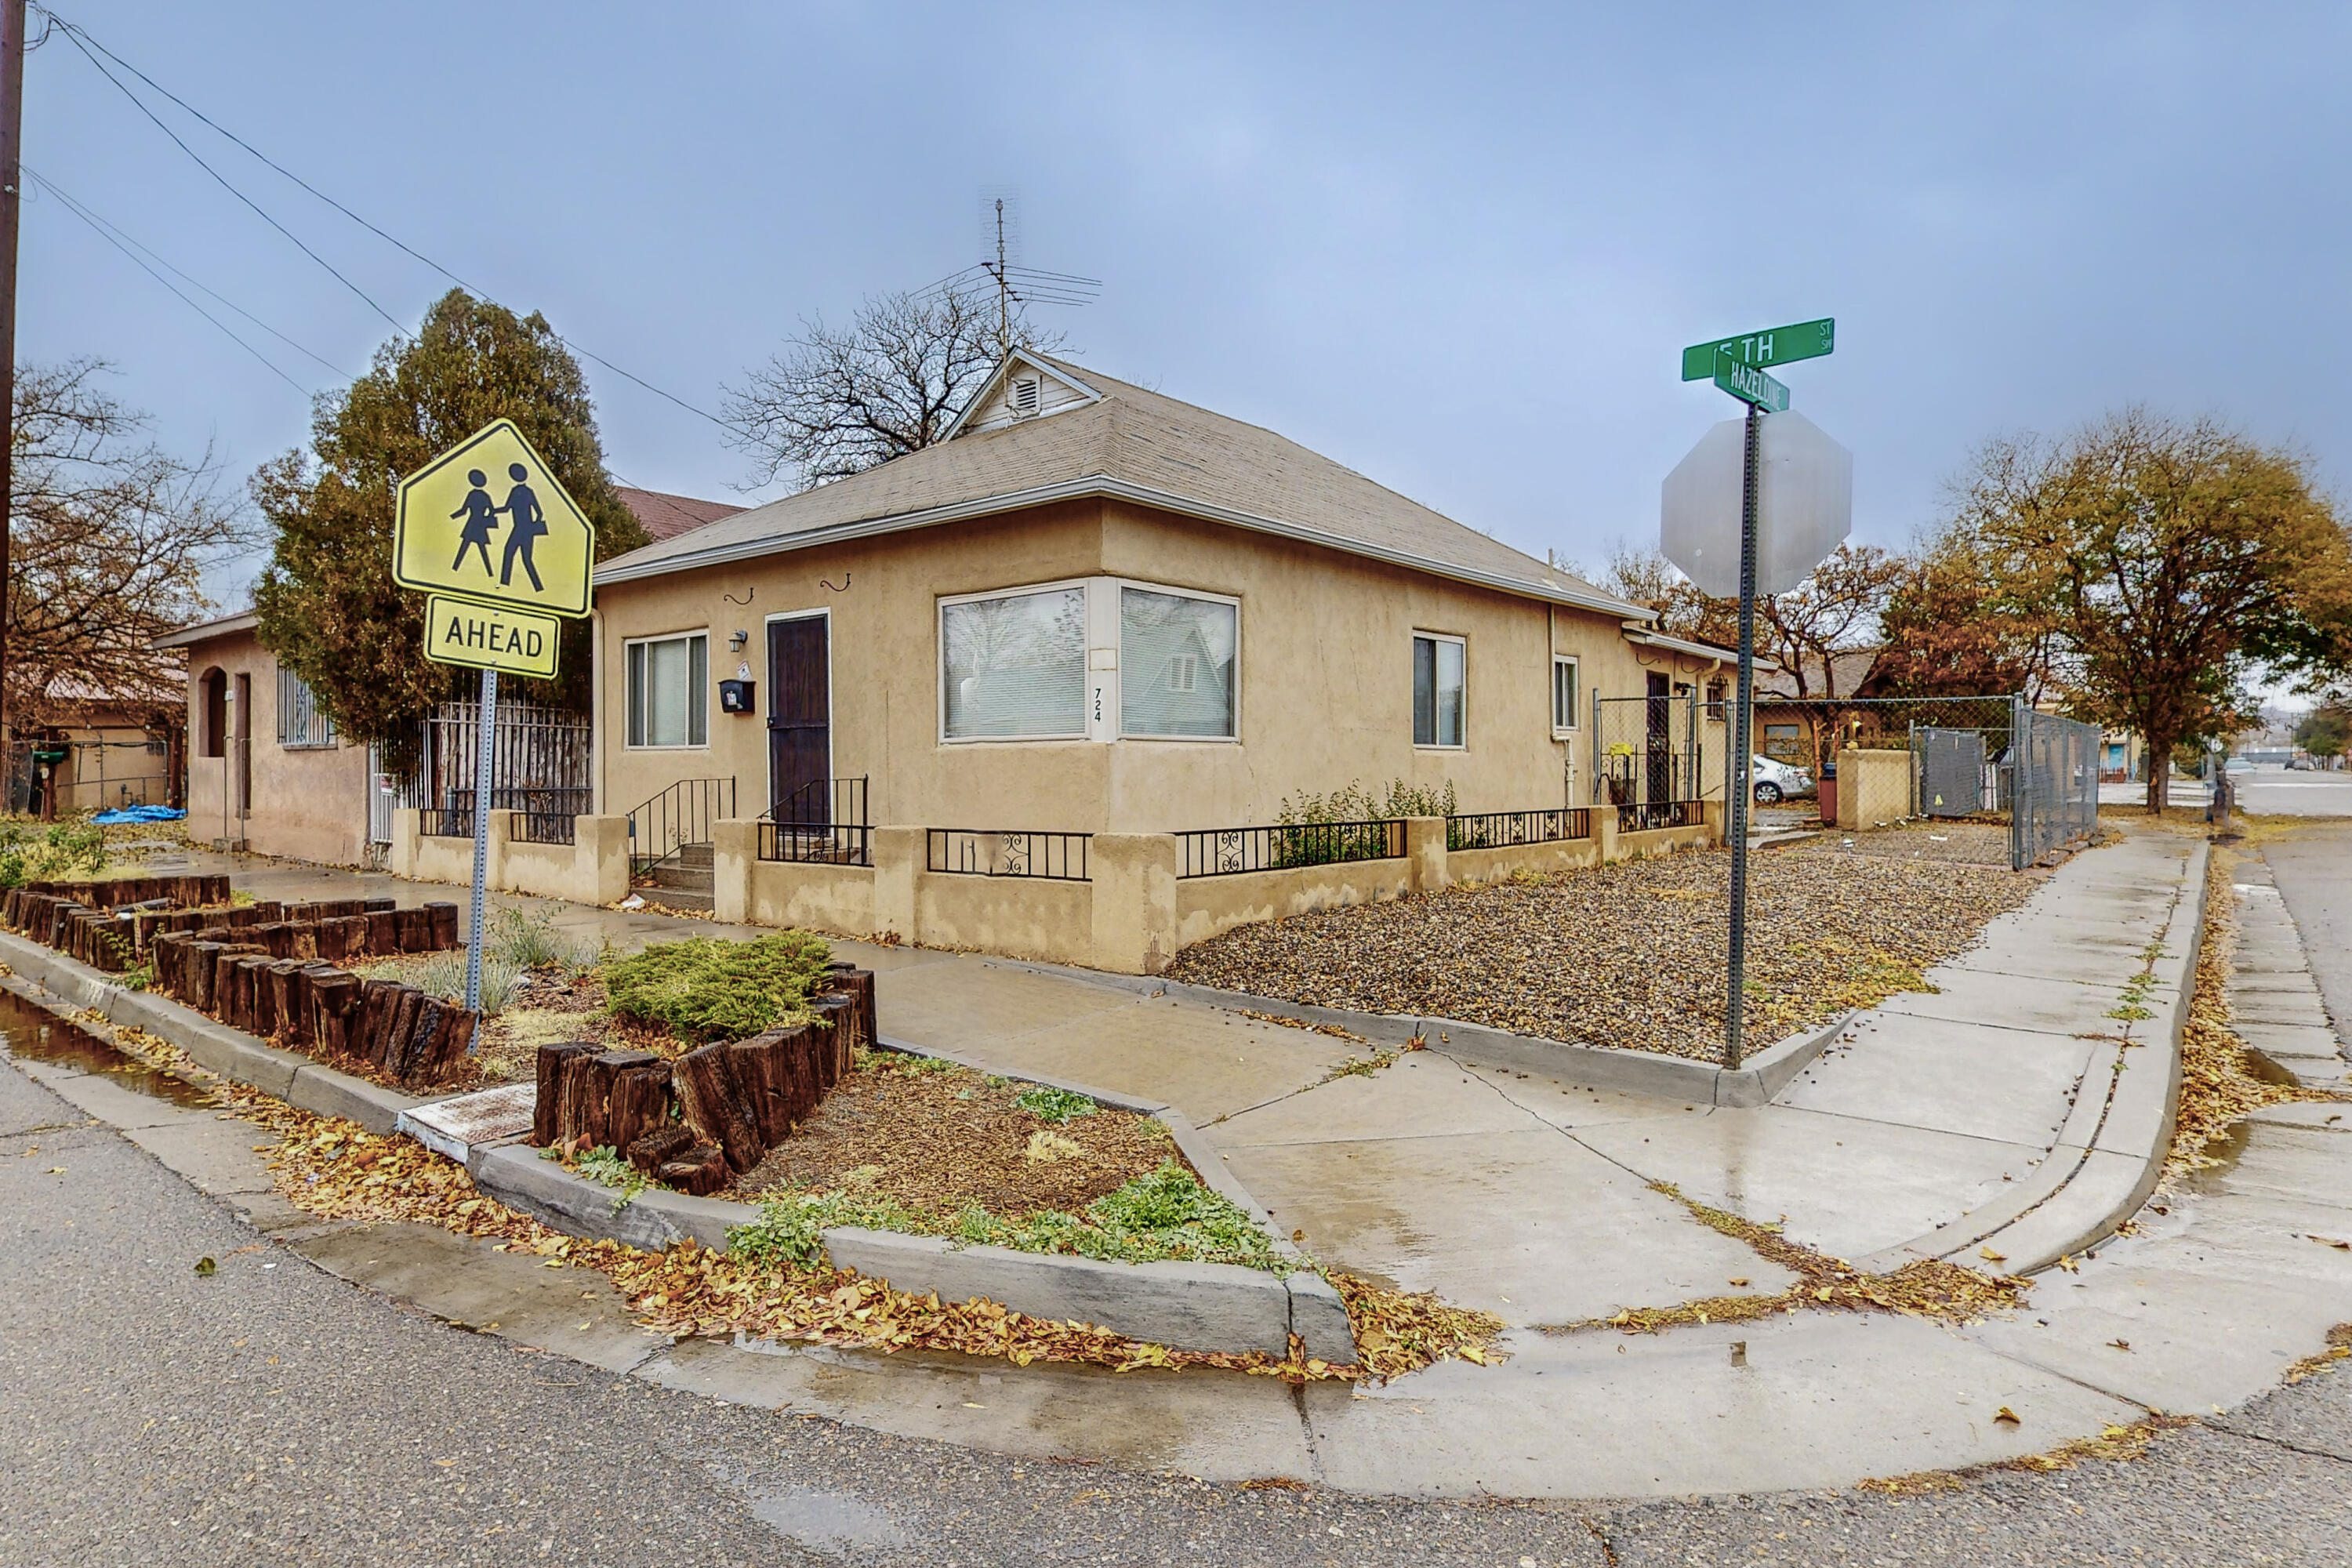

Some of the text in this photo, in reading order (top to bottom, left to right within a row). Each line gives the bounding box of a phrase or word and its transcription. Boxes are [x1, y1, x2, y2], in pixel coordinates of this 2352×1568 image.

[1820, 320, 1832, 336] ST
[1731, 361, 1781, 411] HAZELDINE
[445, 616, 542, 657] AHEAD
